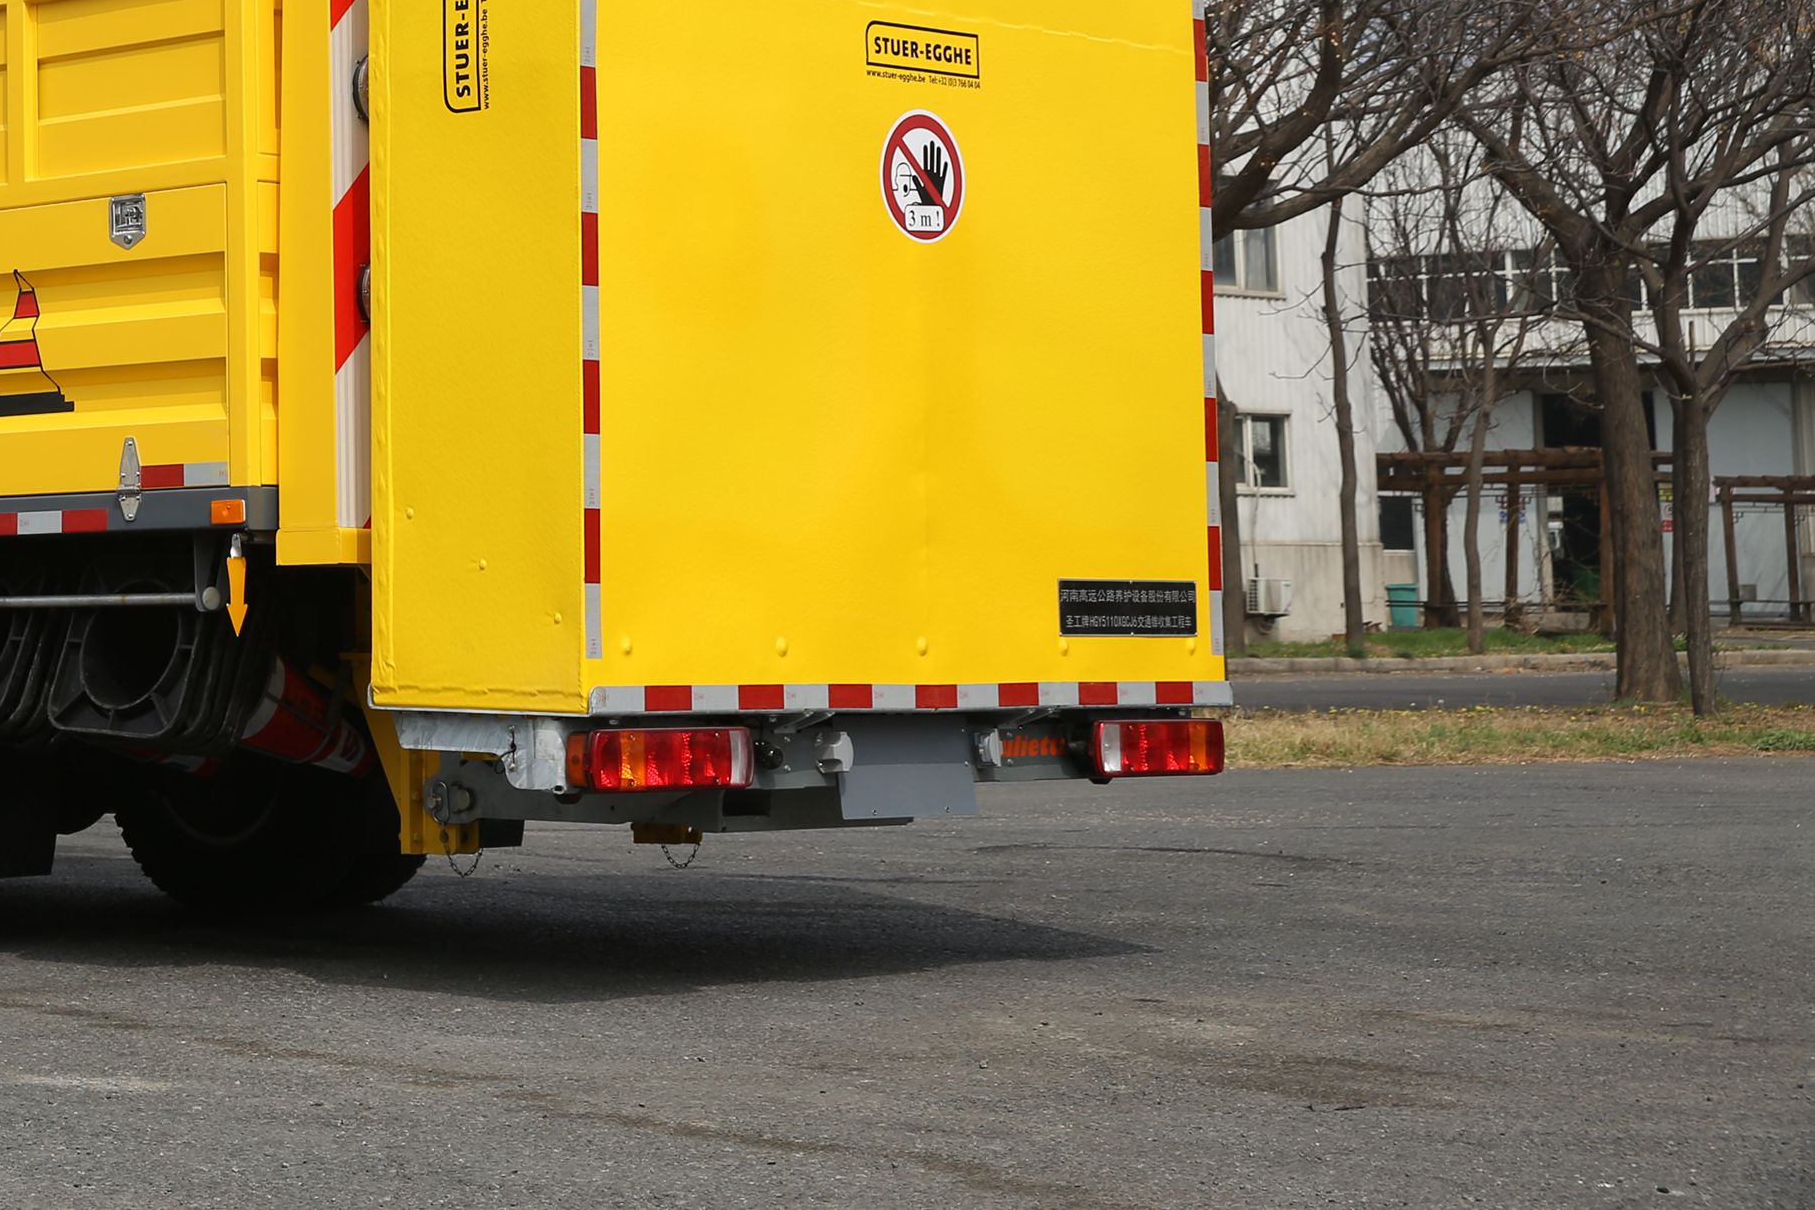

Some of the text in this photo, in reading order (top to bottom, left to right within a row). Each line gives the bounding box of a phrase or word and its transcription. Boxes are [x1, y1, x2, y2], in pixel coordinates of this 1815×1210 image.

[480, 8, 489, 110] www.stuer-egghe.be
[874, 36, 971, 65] STUER-EGGHE
[866, 69, 925, 83] www.stuer-egghe.be
[908, 210, 916, 227] 3
